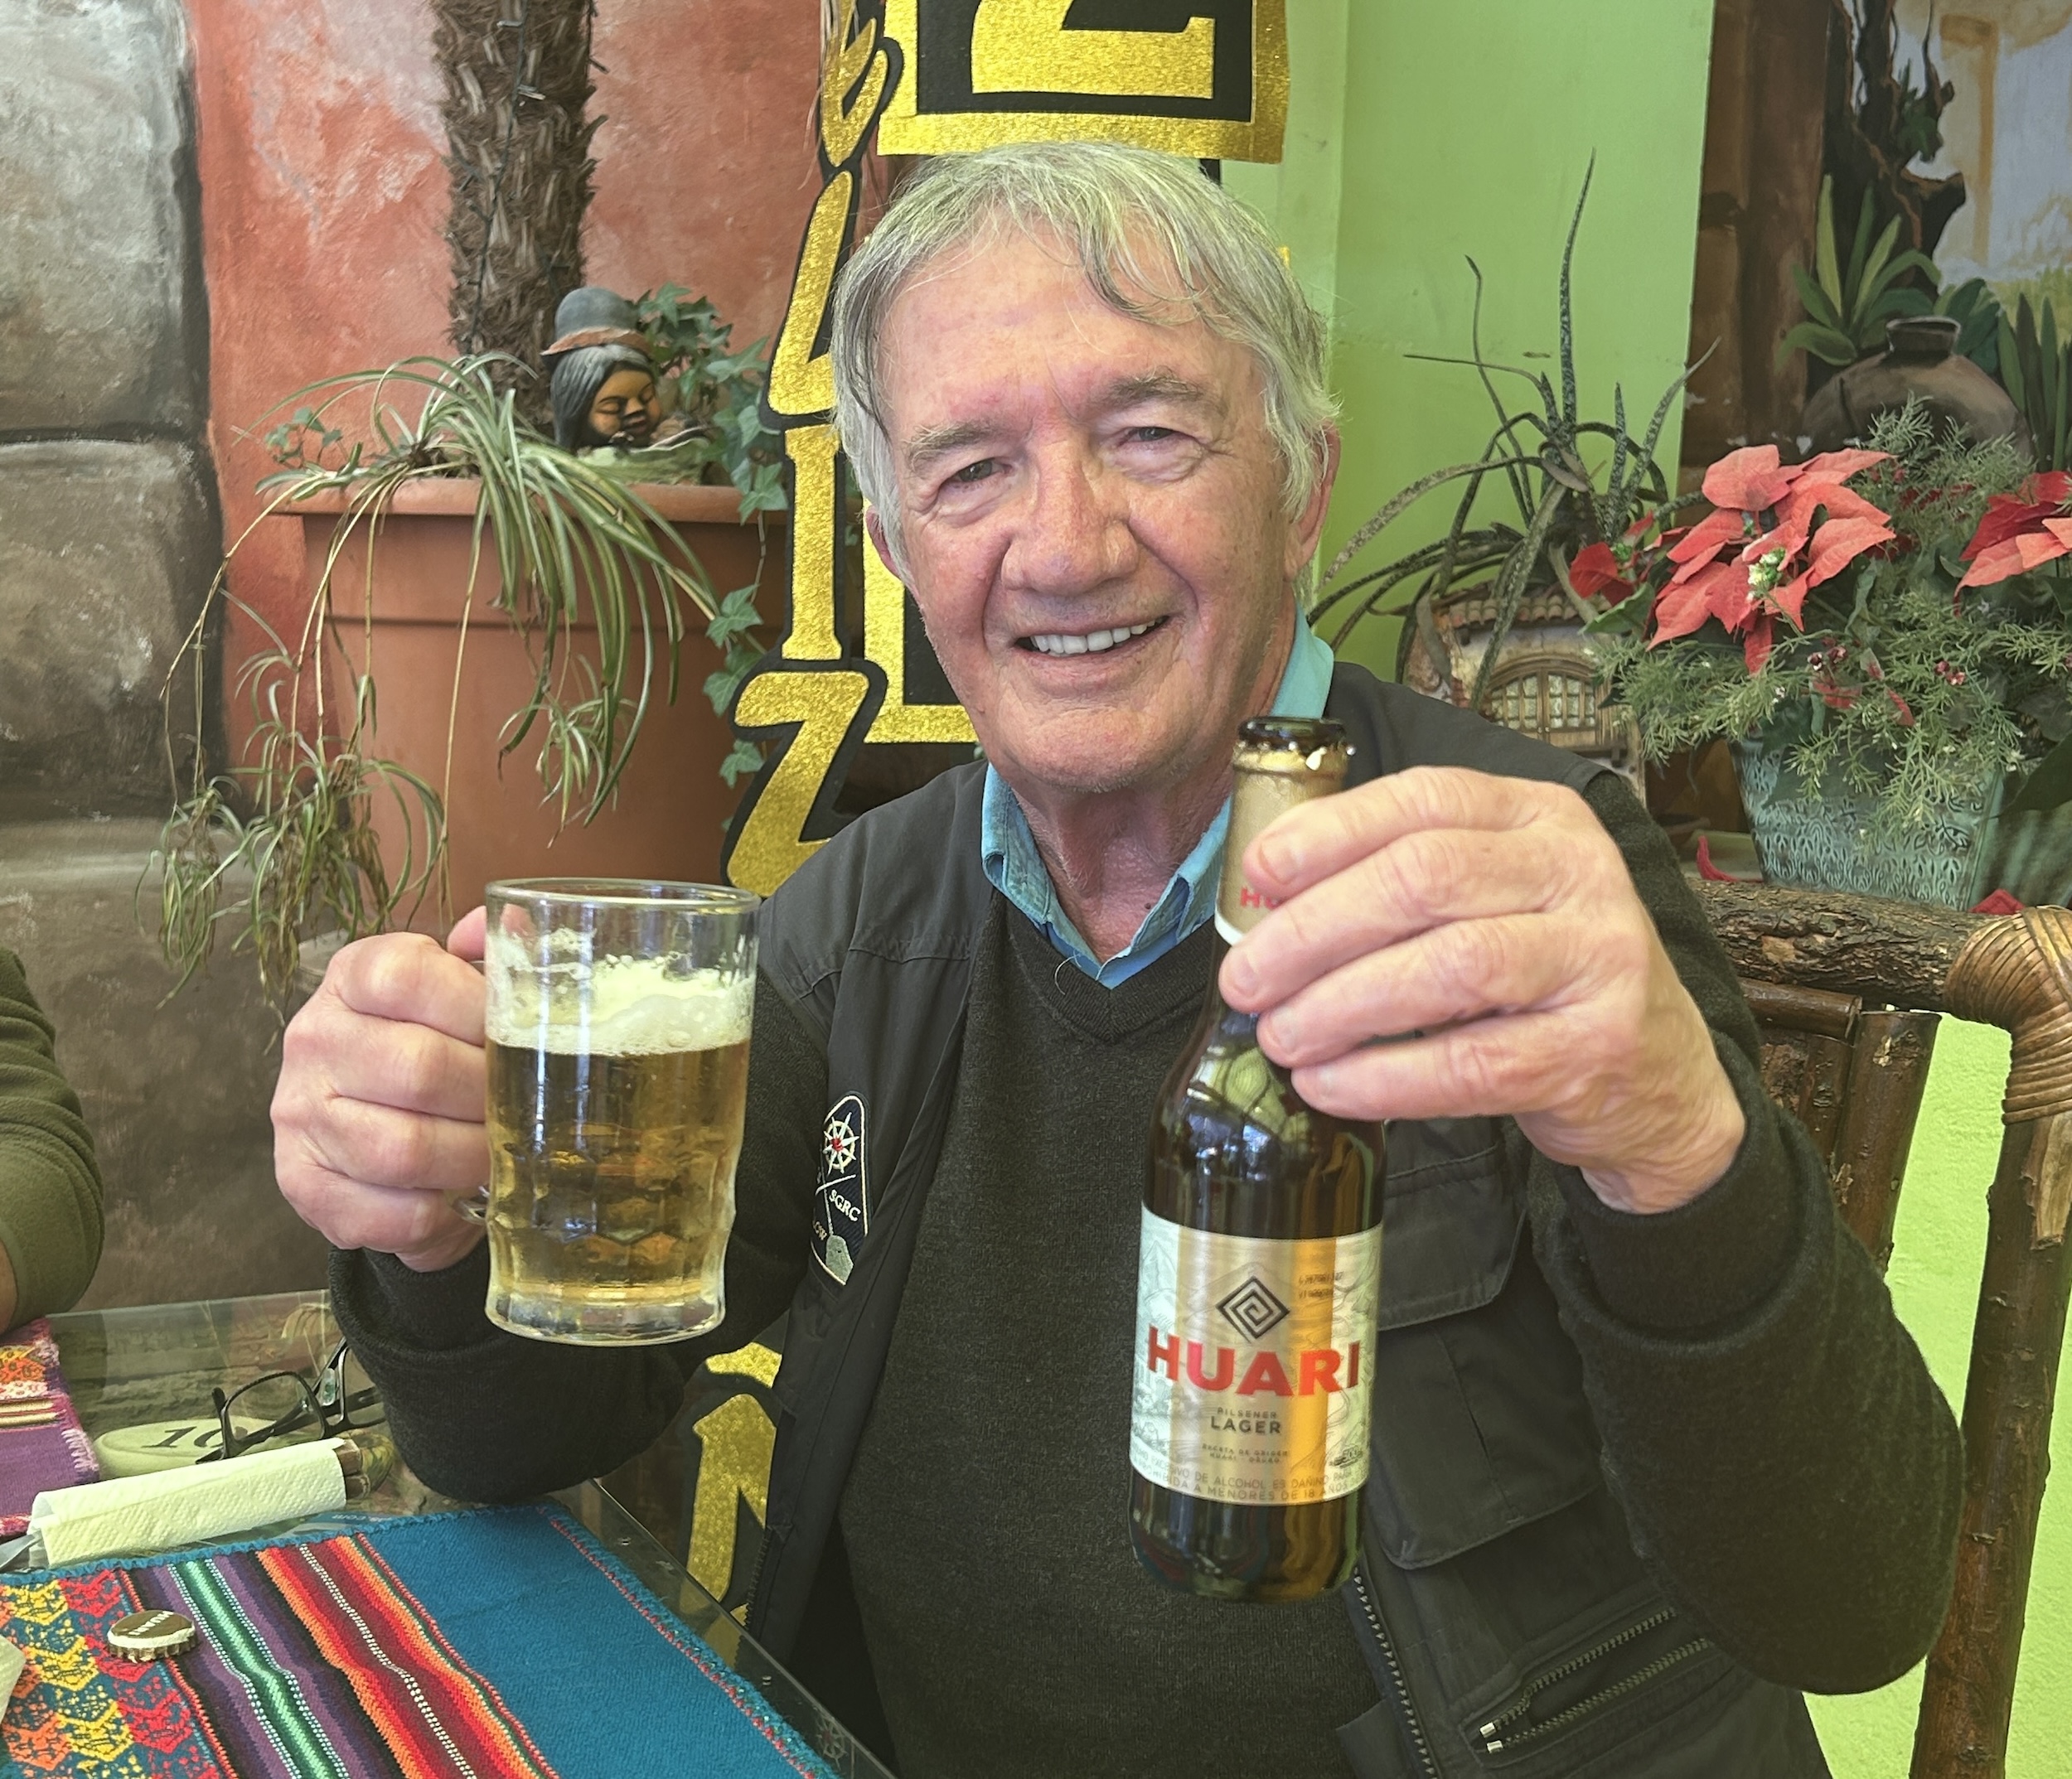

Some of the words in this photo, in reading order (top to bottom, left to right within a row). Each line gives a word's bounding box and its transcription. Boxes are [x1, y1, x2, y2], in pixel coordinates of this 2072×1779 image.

[829, 1189, 861, 1221] SGRC
[1147, 1326, 1361, 1397] HUARI
[1217, 1407, 1277, 1419] PILSENER
[1211, 1416, 1281, 1434] LAGER
[1194, 1471, 1208, 1483] DE
[1213, 1476, 1267, 1489] ALCOHOL
[1273, 1478, 1286, 1490] ES
[1291, 1475, 1329, 1488] DAÑINO
[1193, 1483, 1202, 1493] A
[1208, 1485, 1275, 1501] MENORES
[1280, 1489, 1299, 1501] DE
[1304, 1488, 1314, 1498] 18
